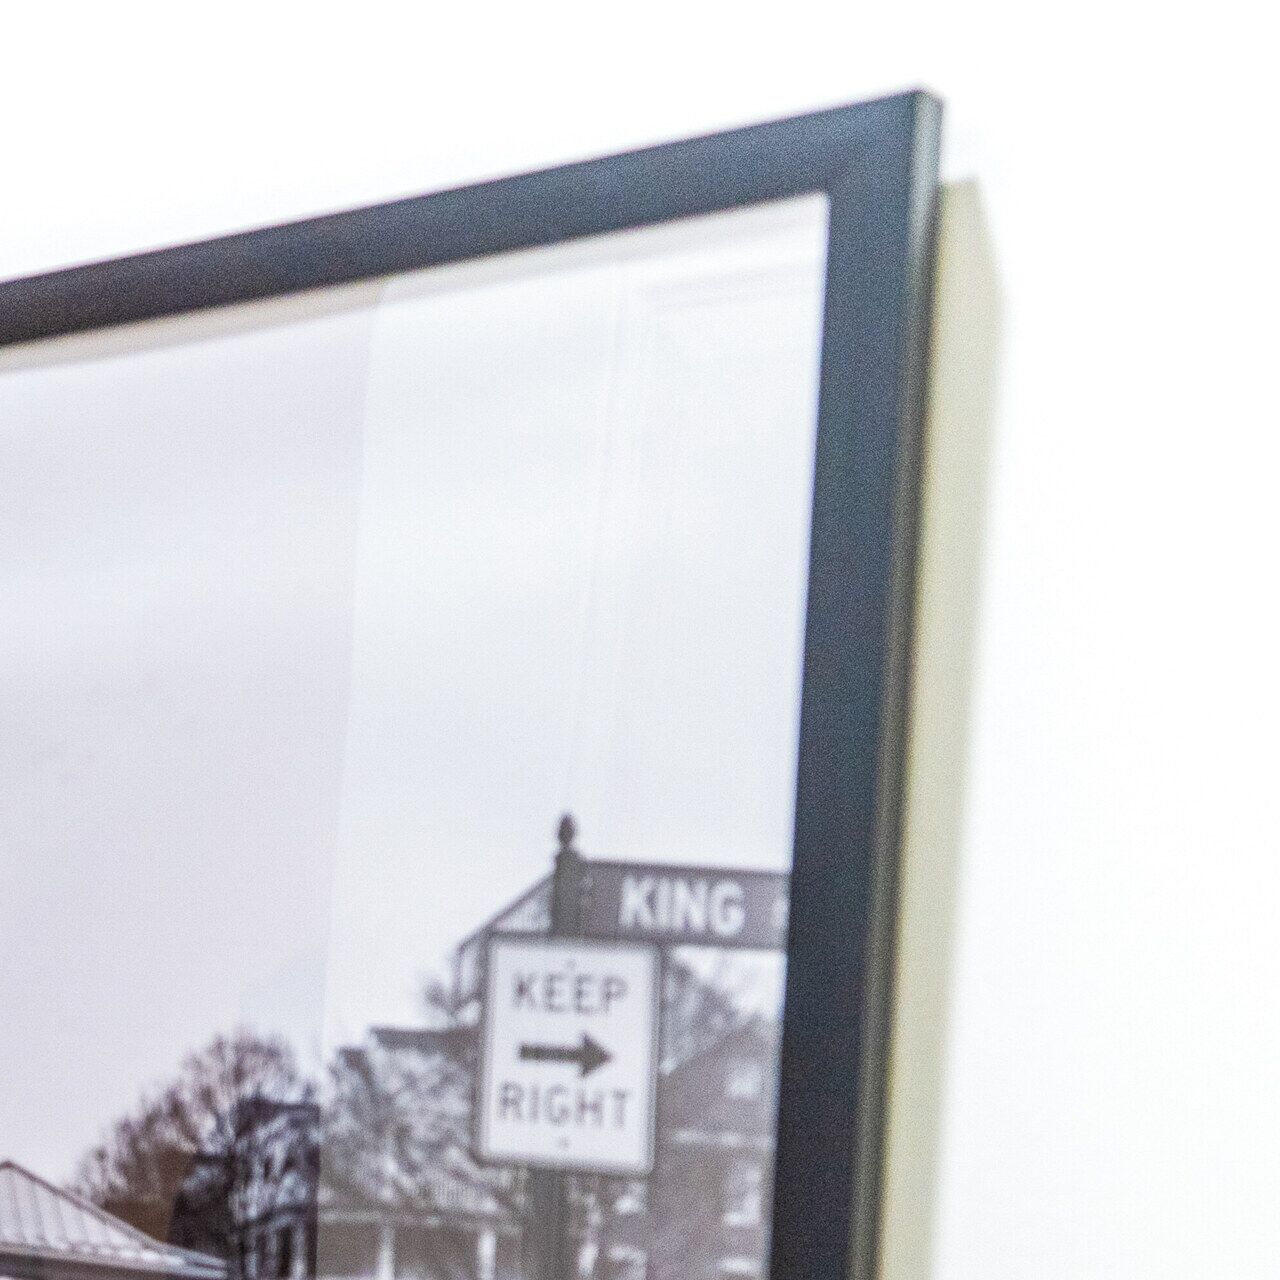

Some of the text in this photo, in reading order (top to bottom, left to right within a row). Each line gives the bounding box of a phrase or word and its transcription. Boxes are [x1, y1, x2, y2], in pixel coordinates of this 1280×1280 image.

[619, 874, 746, 936] KING
[512, 972, 628, 1016] KEEP
[496, 1081, 633, 1130] RIGHT
